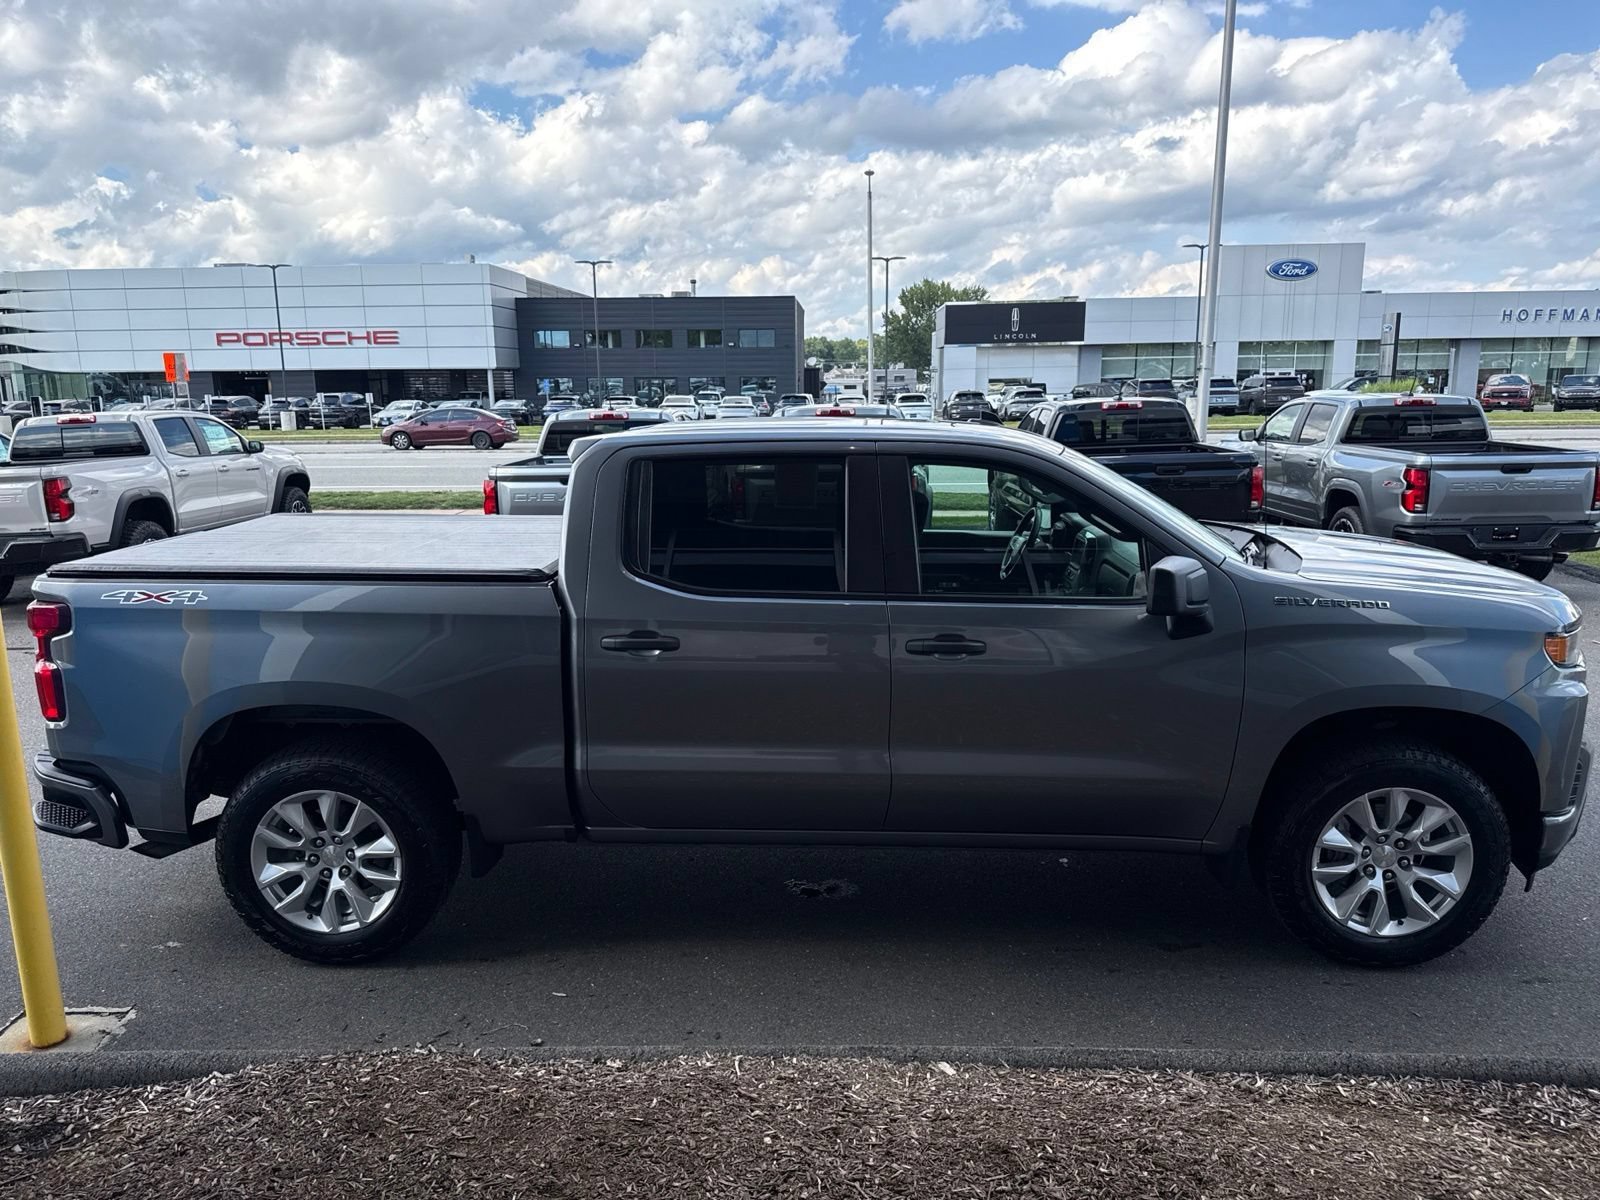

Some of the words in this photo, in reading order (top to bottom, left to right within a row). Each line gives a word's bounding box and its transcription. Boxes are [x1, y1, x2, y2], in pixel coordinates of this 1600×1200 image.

[1278, 262, 1309, 276] Ford
[215, 330, 400, 347] PORSCHE
[1449, 480, 1582, 492] CHEVROLET
[1273, 596, 1391, 610] SILVERADO
